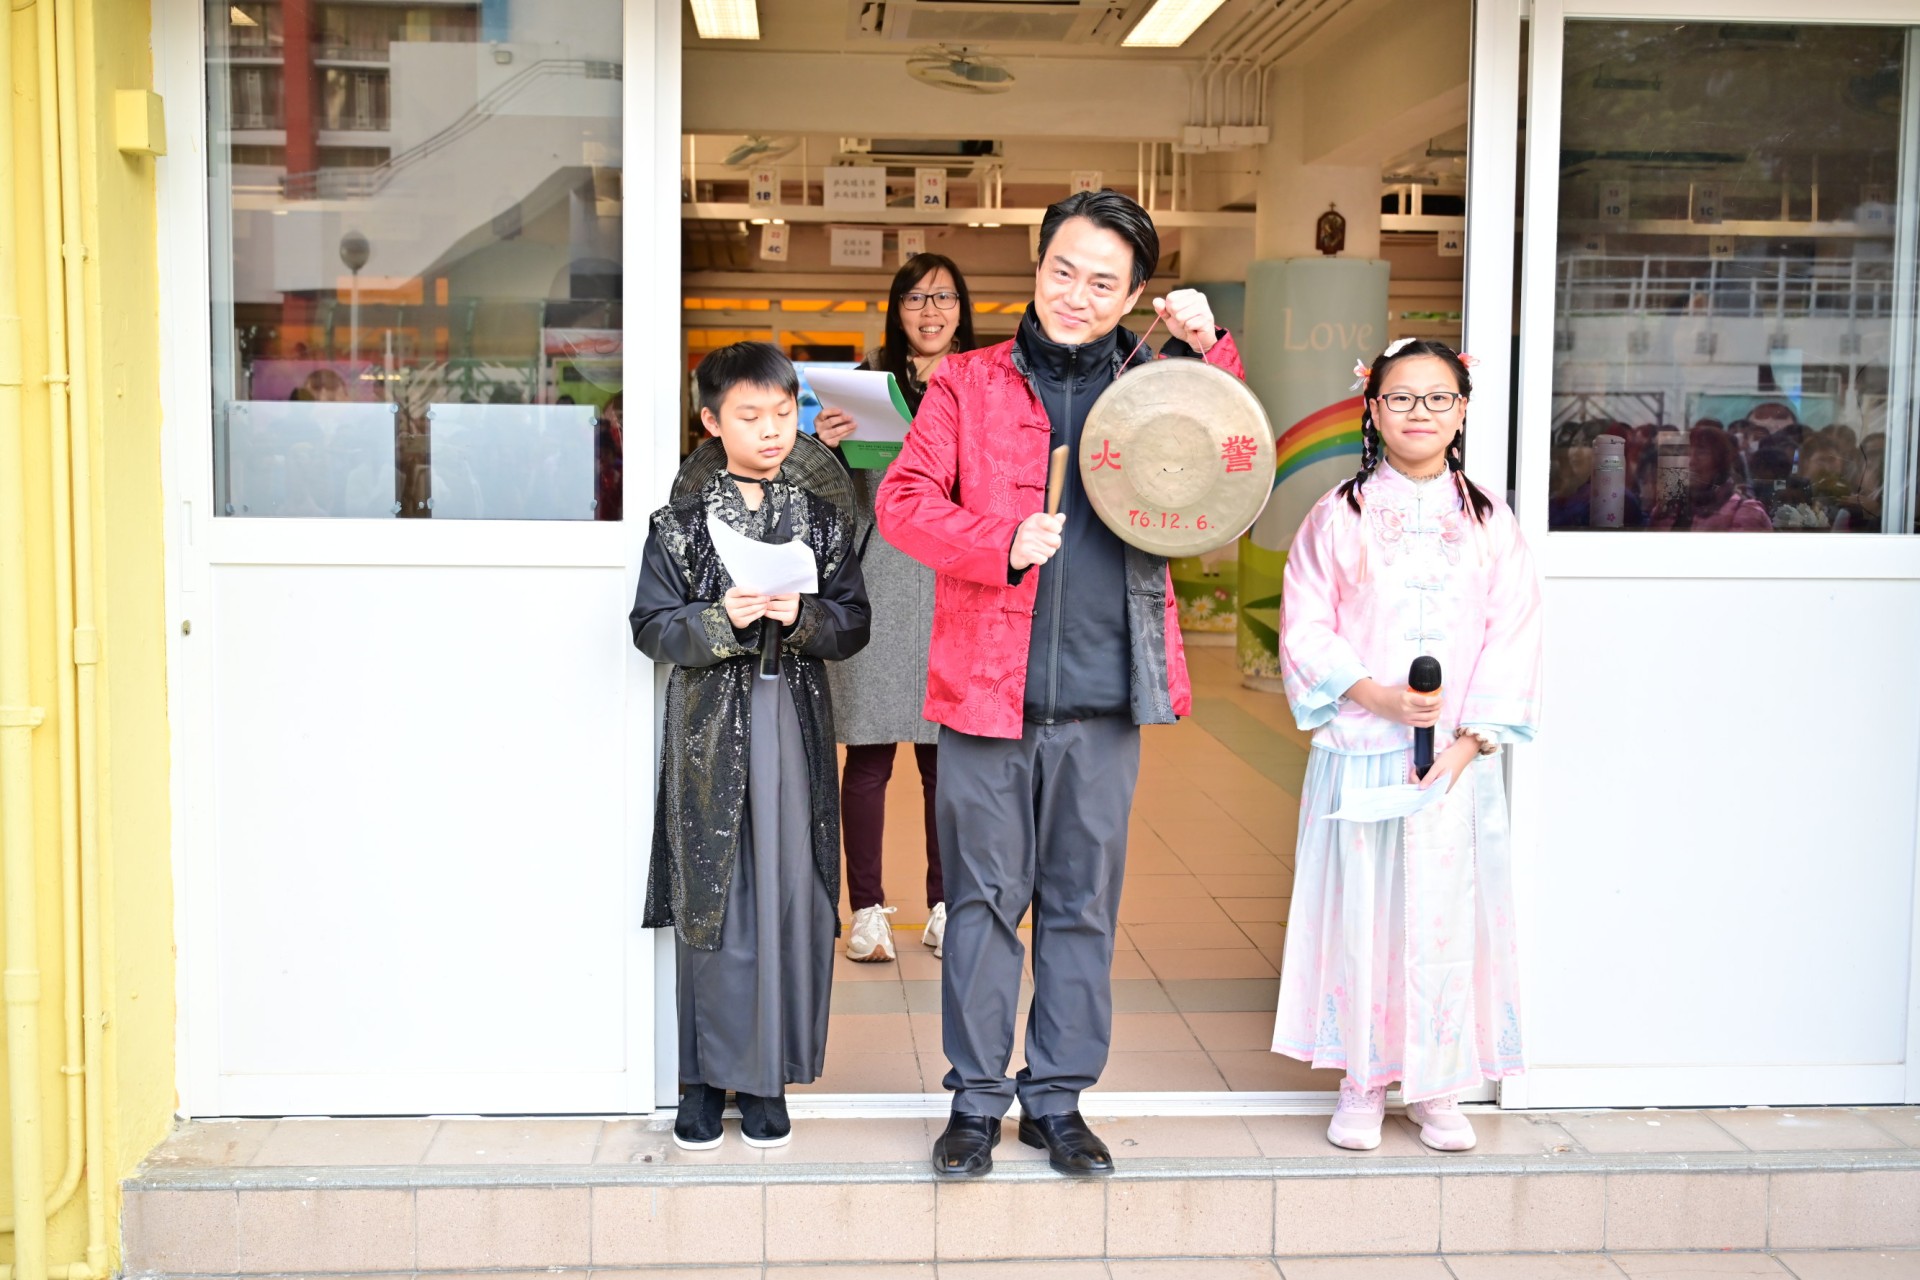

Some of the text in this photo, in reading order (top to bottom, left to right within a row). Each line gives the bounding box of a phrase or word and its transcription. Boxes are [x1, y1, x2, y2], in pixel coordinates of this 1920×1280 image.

[924, 195, 940, 204] 2A
[1606, 206, 1621, 215] 1D
[1700, 207, 1714, 216] 1C
[768, 245, 781, 253] 4C
[1444, 241, 1458, 249] 4A
[1283, 307, 1373, 352] Love
[1090, 435, 1259, 473] 火 警
